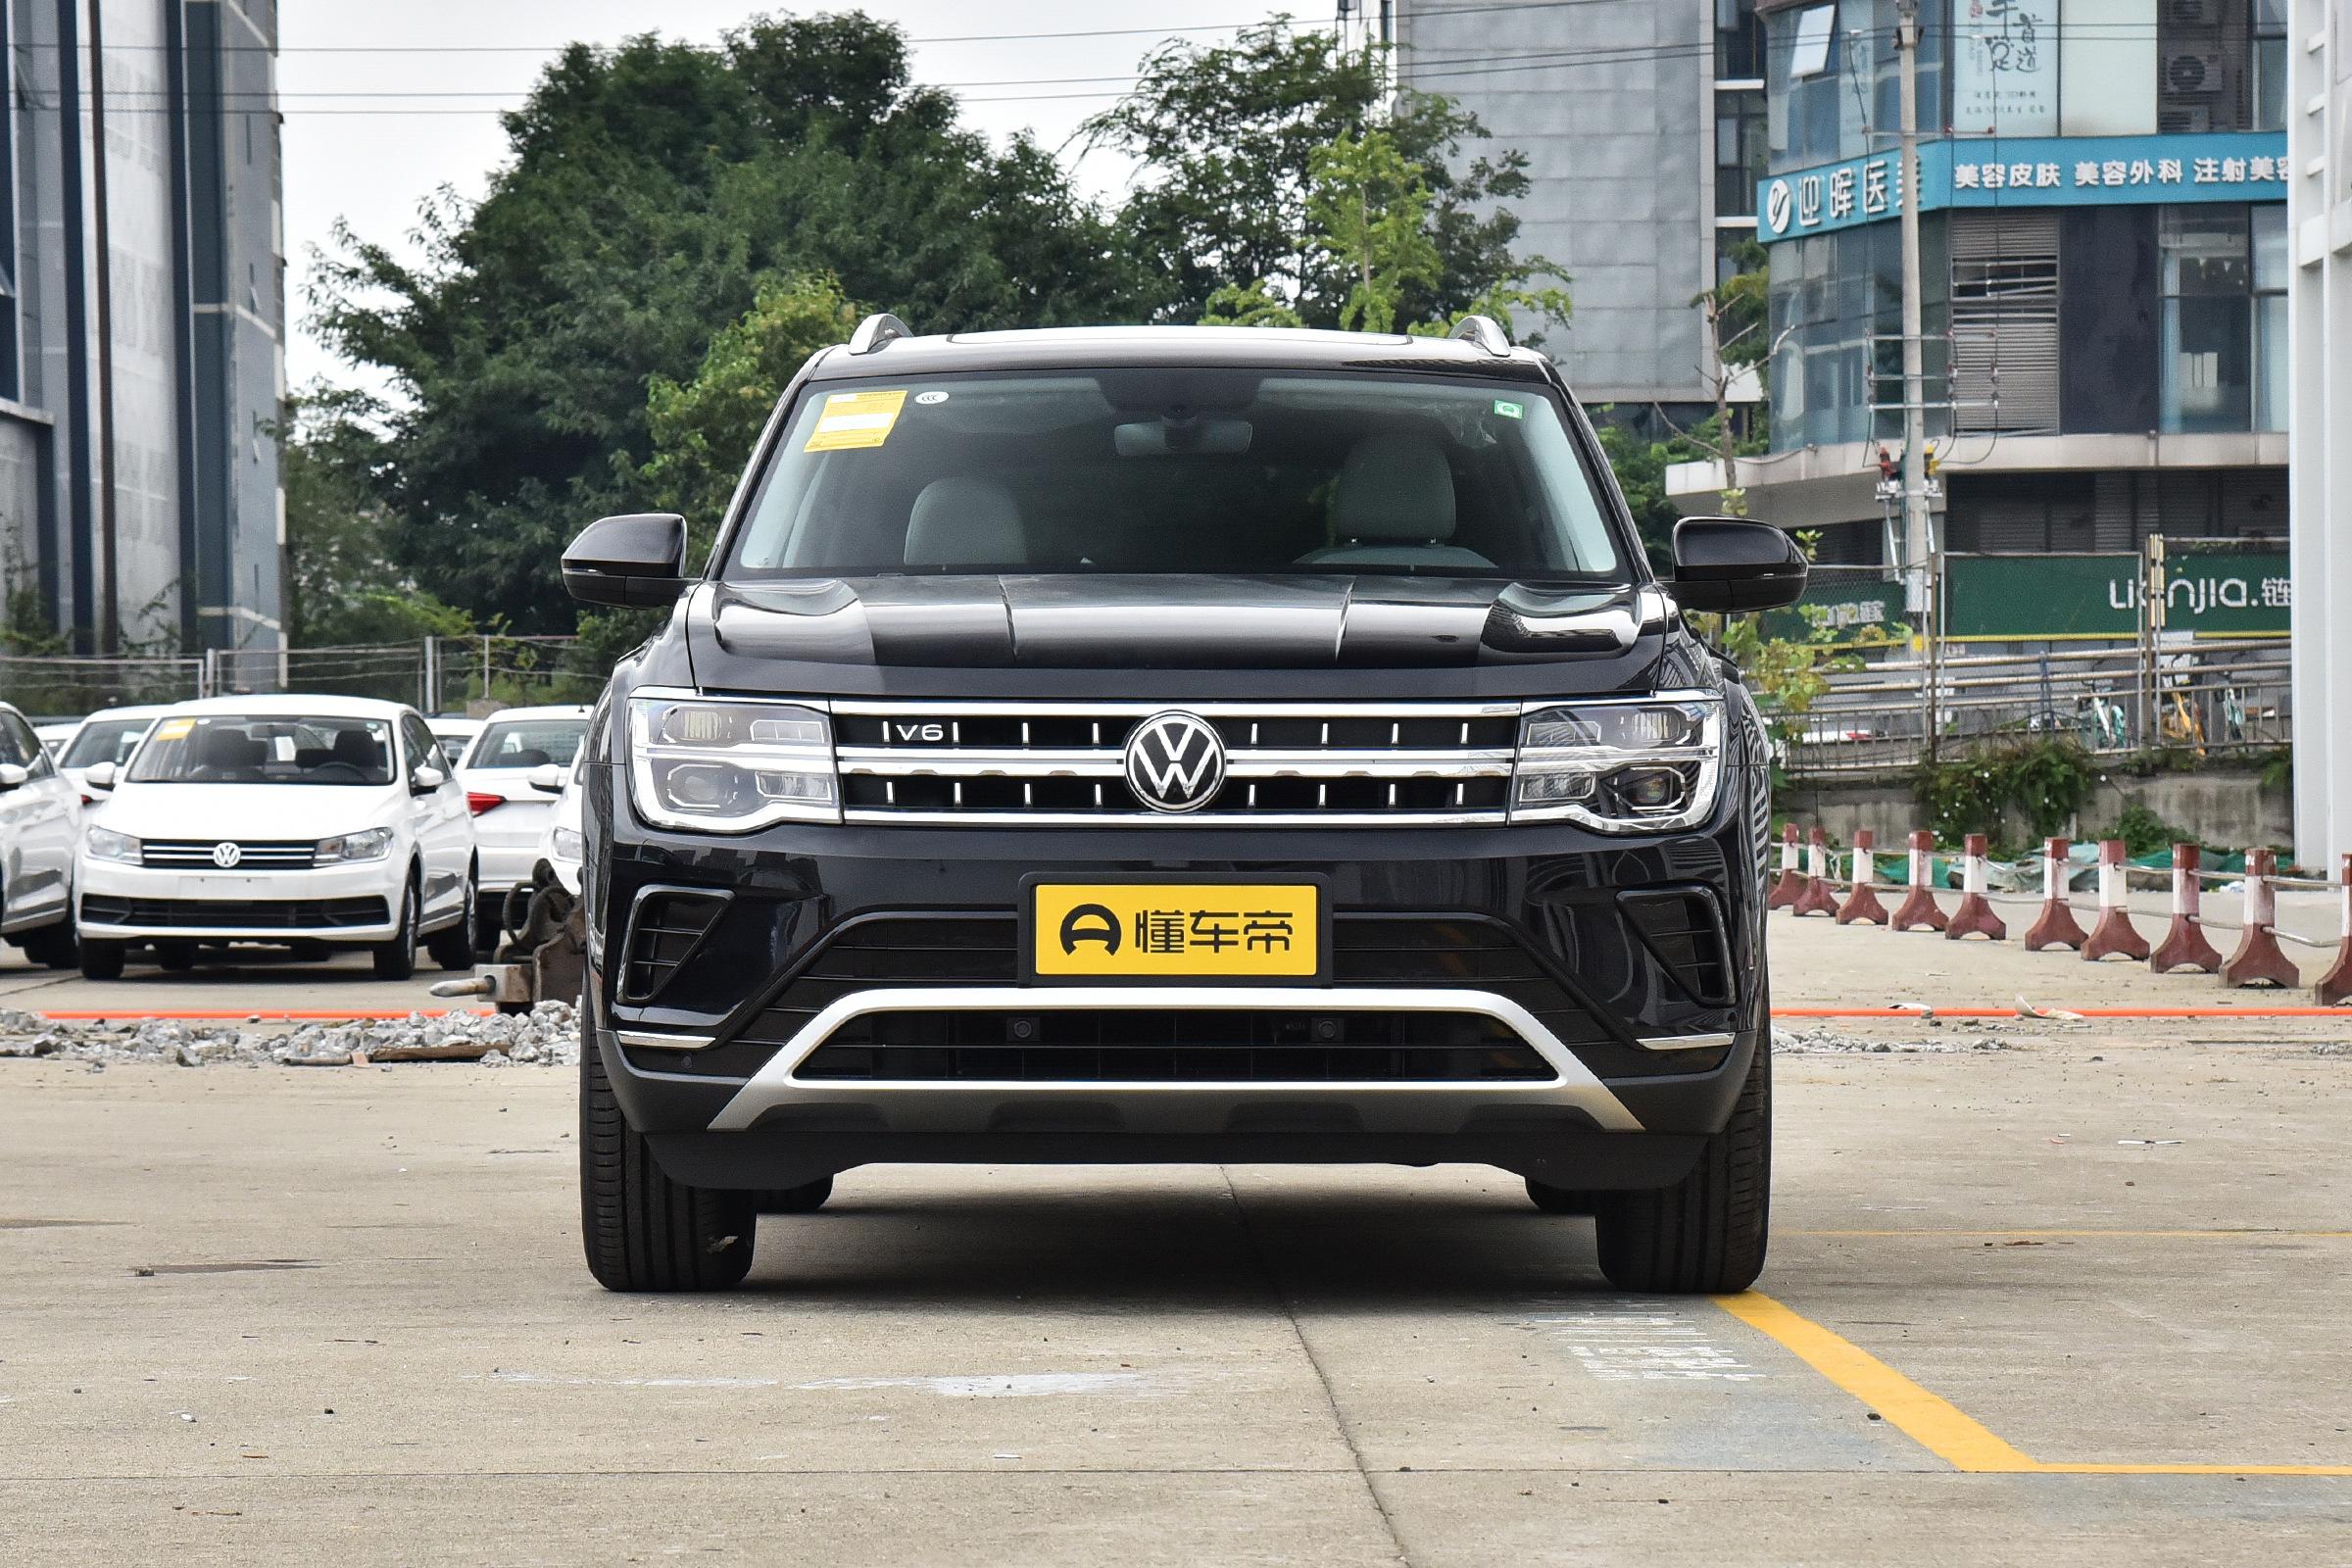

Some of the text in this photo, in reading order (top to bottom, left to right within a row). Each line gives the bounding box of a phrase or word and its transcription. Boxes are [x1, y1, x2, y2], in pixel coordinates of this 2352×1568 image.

[1955, 162, 2061, 188] 美容皮肤
[2075, 158, 2183, 186] 美容外科
[896, 723, 944, 742] V6
[1135, 909, 1294, 955] 懂车帝
